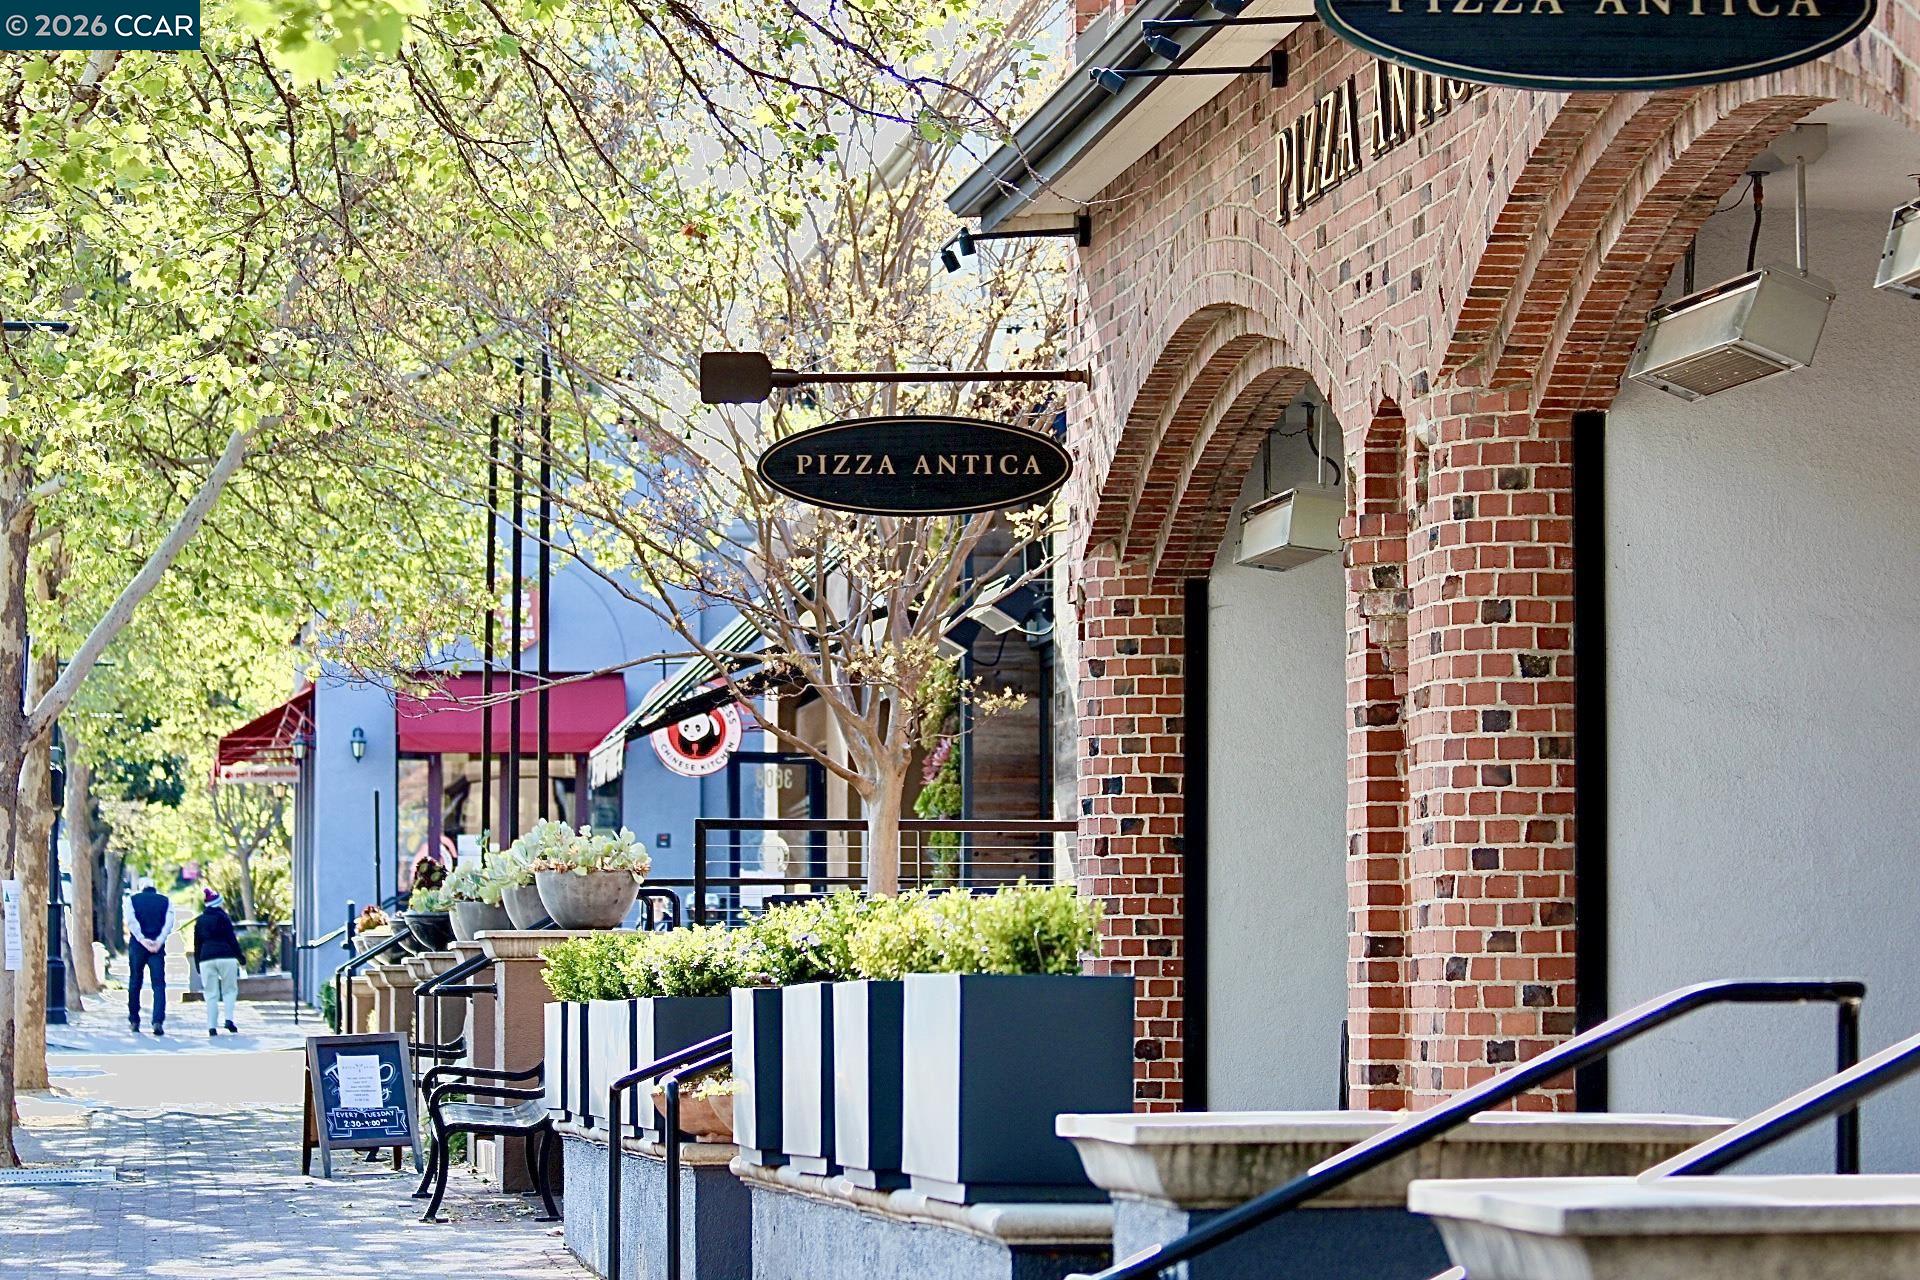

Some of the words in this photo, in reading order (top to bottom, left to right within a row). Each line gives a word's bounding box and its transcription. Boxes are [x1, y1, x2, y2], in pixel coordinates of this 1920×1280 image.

[1276, 78, 1361, 225] PIZZA
[1370, 58, 1482, 159] ANT
[796, 454, 897, 475] PIZZA
[913, 454, 1043, 475] ANTICA
[661, 743, 696, 771] CHINESE
[700, 741, 735, 770] KITCHEN
[363, 1110, 394, 1118] TUESDAY
